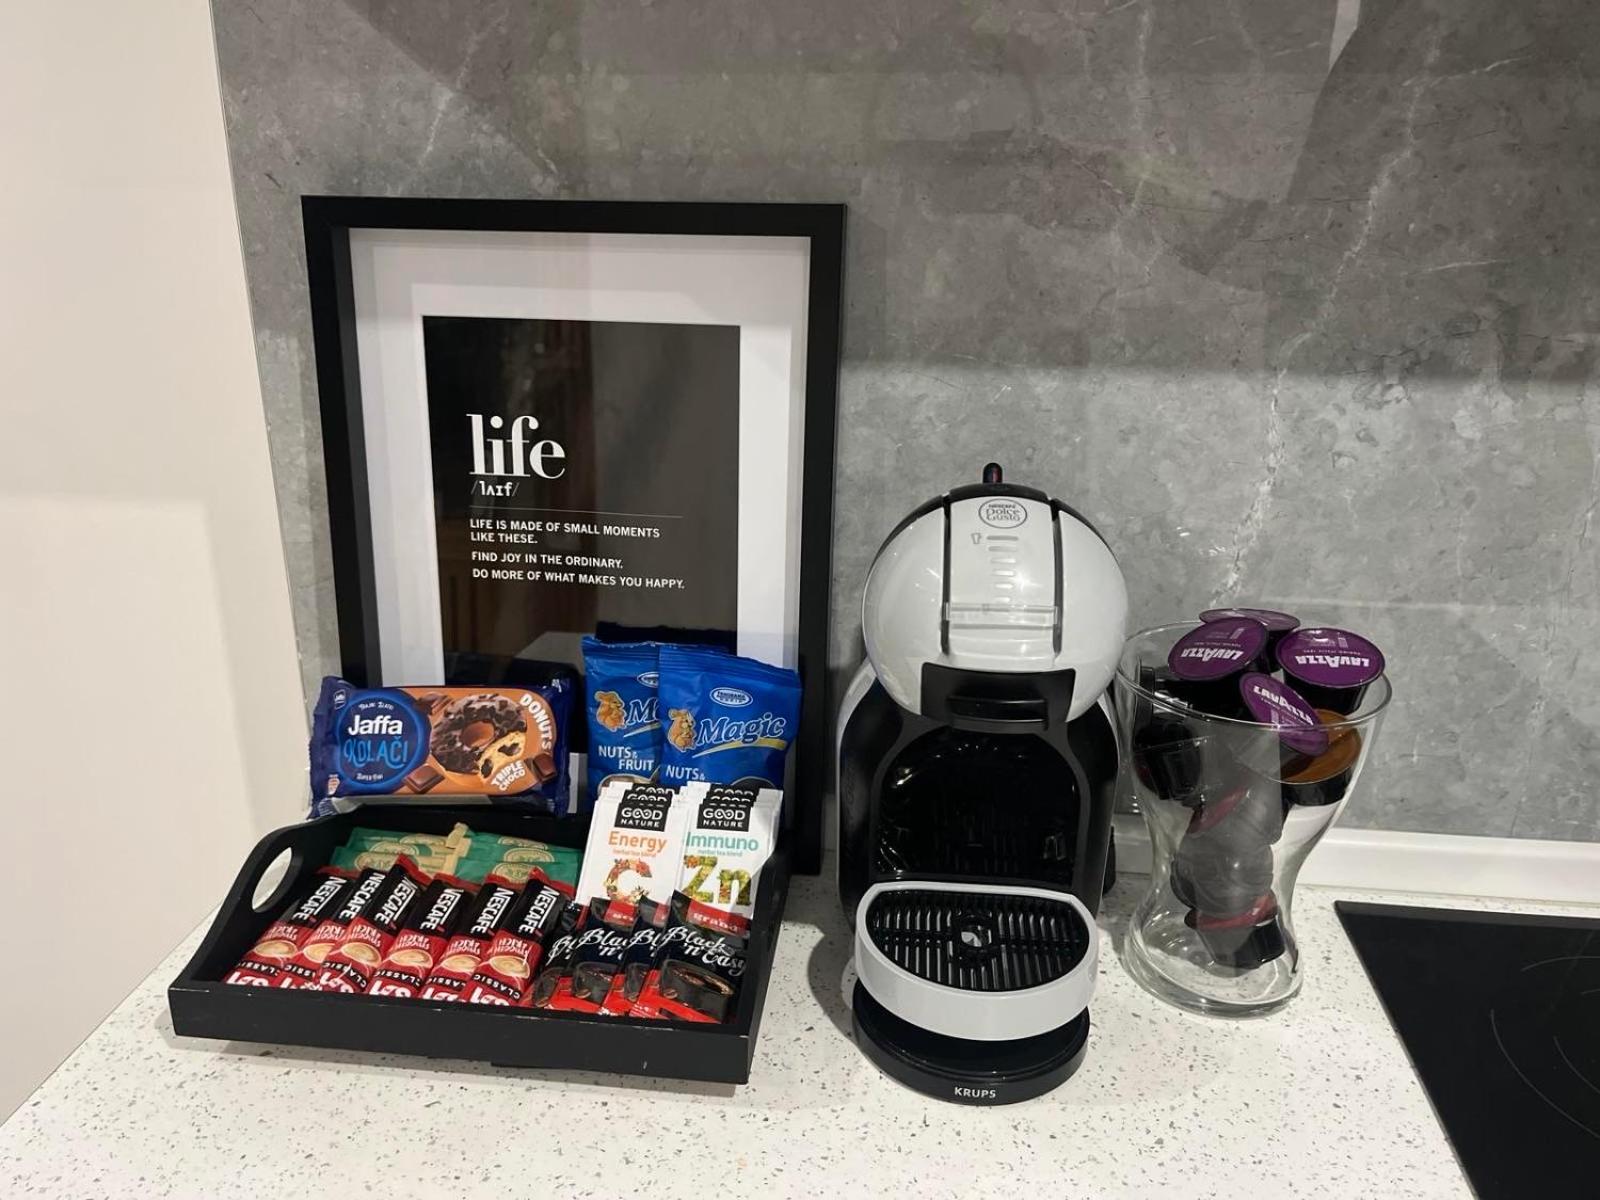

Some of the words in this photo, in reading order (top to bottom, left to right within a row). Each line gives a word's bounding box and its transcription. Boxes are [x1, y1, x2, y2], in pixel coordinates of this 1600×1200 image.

[466, 413, 565, 479] life
[470, 519, 493, 529] LIFE
[496, 519, 507, 530] IS
[510, 520, 543, 532] MADE
[546, 521, 561, 532] OF
[564, 523, 600, 535] SMALL
[603, 525, 660, 538] MOMENTS
[471, 532, 495, 542] LIKE
[498, 532, 538, 544] THESE.
[472, 551, 498, 562] FIND
[500, 552, 521, 563] JOY
[525, 553, 537, 564] IN
[541, 554, 562, 565] THE
[565, 555, 623, 569] ORDINARY.
[473, 568, 488, 579] DO
[492, 569, 524, 580] MORE
[527, 570, 541, 581] OF
[544, 571, 575, 583] WHAT
[578, 573, 616, 586] MAKES
[619, 576, 642, 588] YOU
[645, 577, 685, 590] HAPPY.
[1180, 647, 1244, 662] LAVAZZA
[1295, 655, 1369, 668] LAVAZZA
[1253, 685, 1314, 725] LAVAZZA
[348, 714, 403, 736] Jaffa
[519, 692, 551, 750] DONUTS
[696, 712, 787, 744] Magic
[491, 760, 524, 785] TRIPLE
[618, 759, 654, 772] FRUIT
[499, 769, 526, 791] CHOCO
[620, 818, 660, 828] NATURE
[621, 807, 663, 820] GOOD
[703, 807, 746, 820] GOOD
[703, 819, 743, 828] NATURE
[608, 831, 668, 853] Energy
[686, 831, 759, 851] Immuno
[656, 926, 735, 957] Black
[702, 946, 747, 977] Easy
[473, 973, 521, 999] CLASSIC
[954, 1086, 996, 1099] KRUPS
